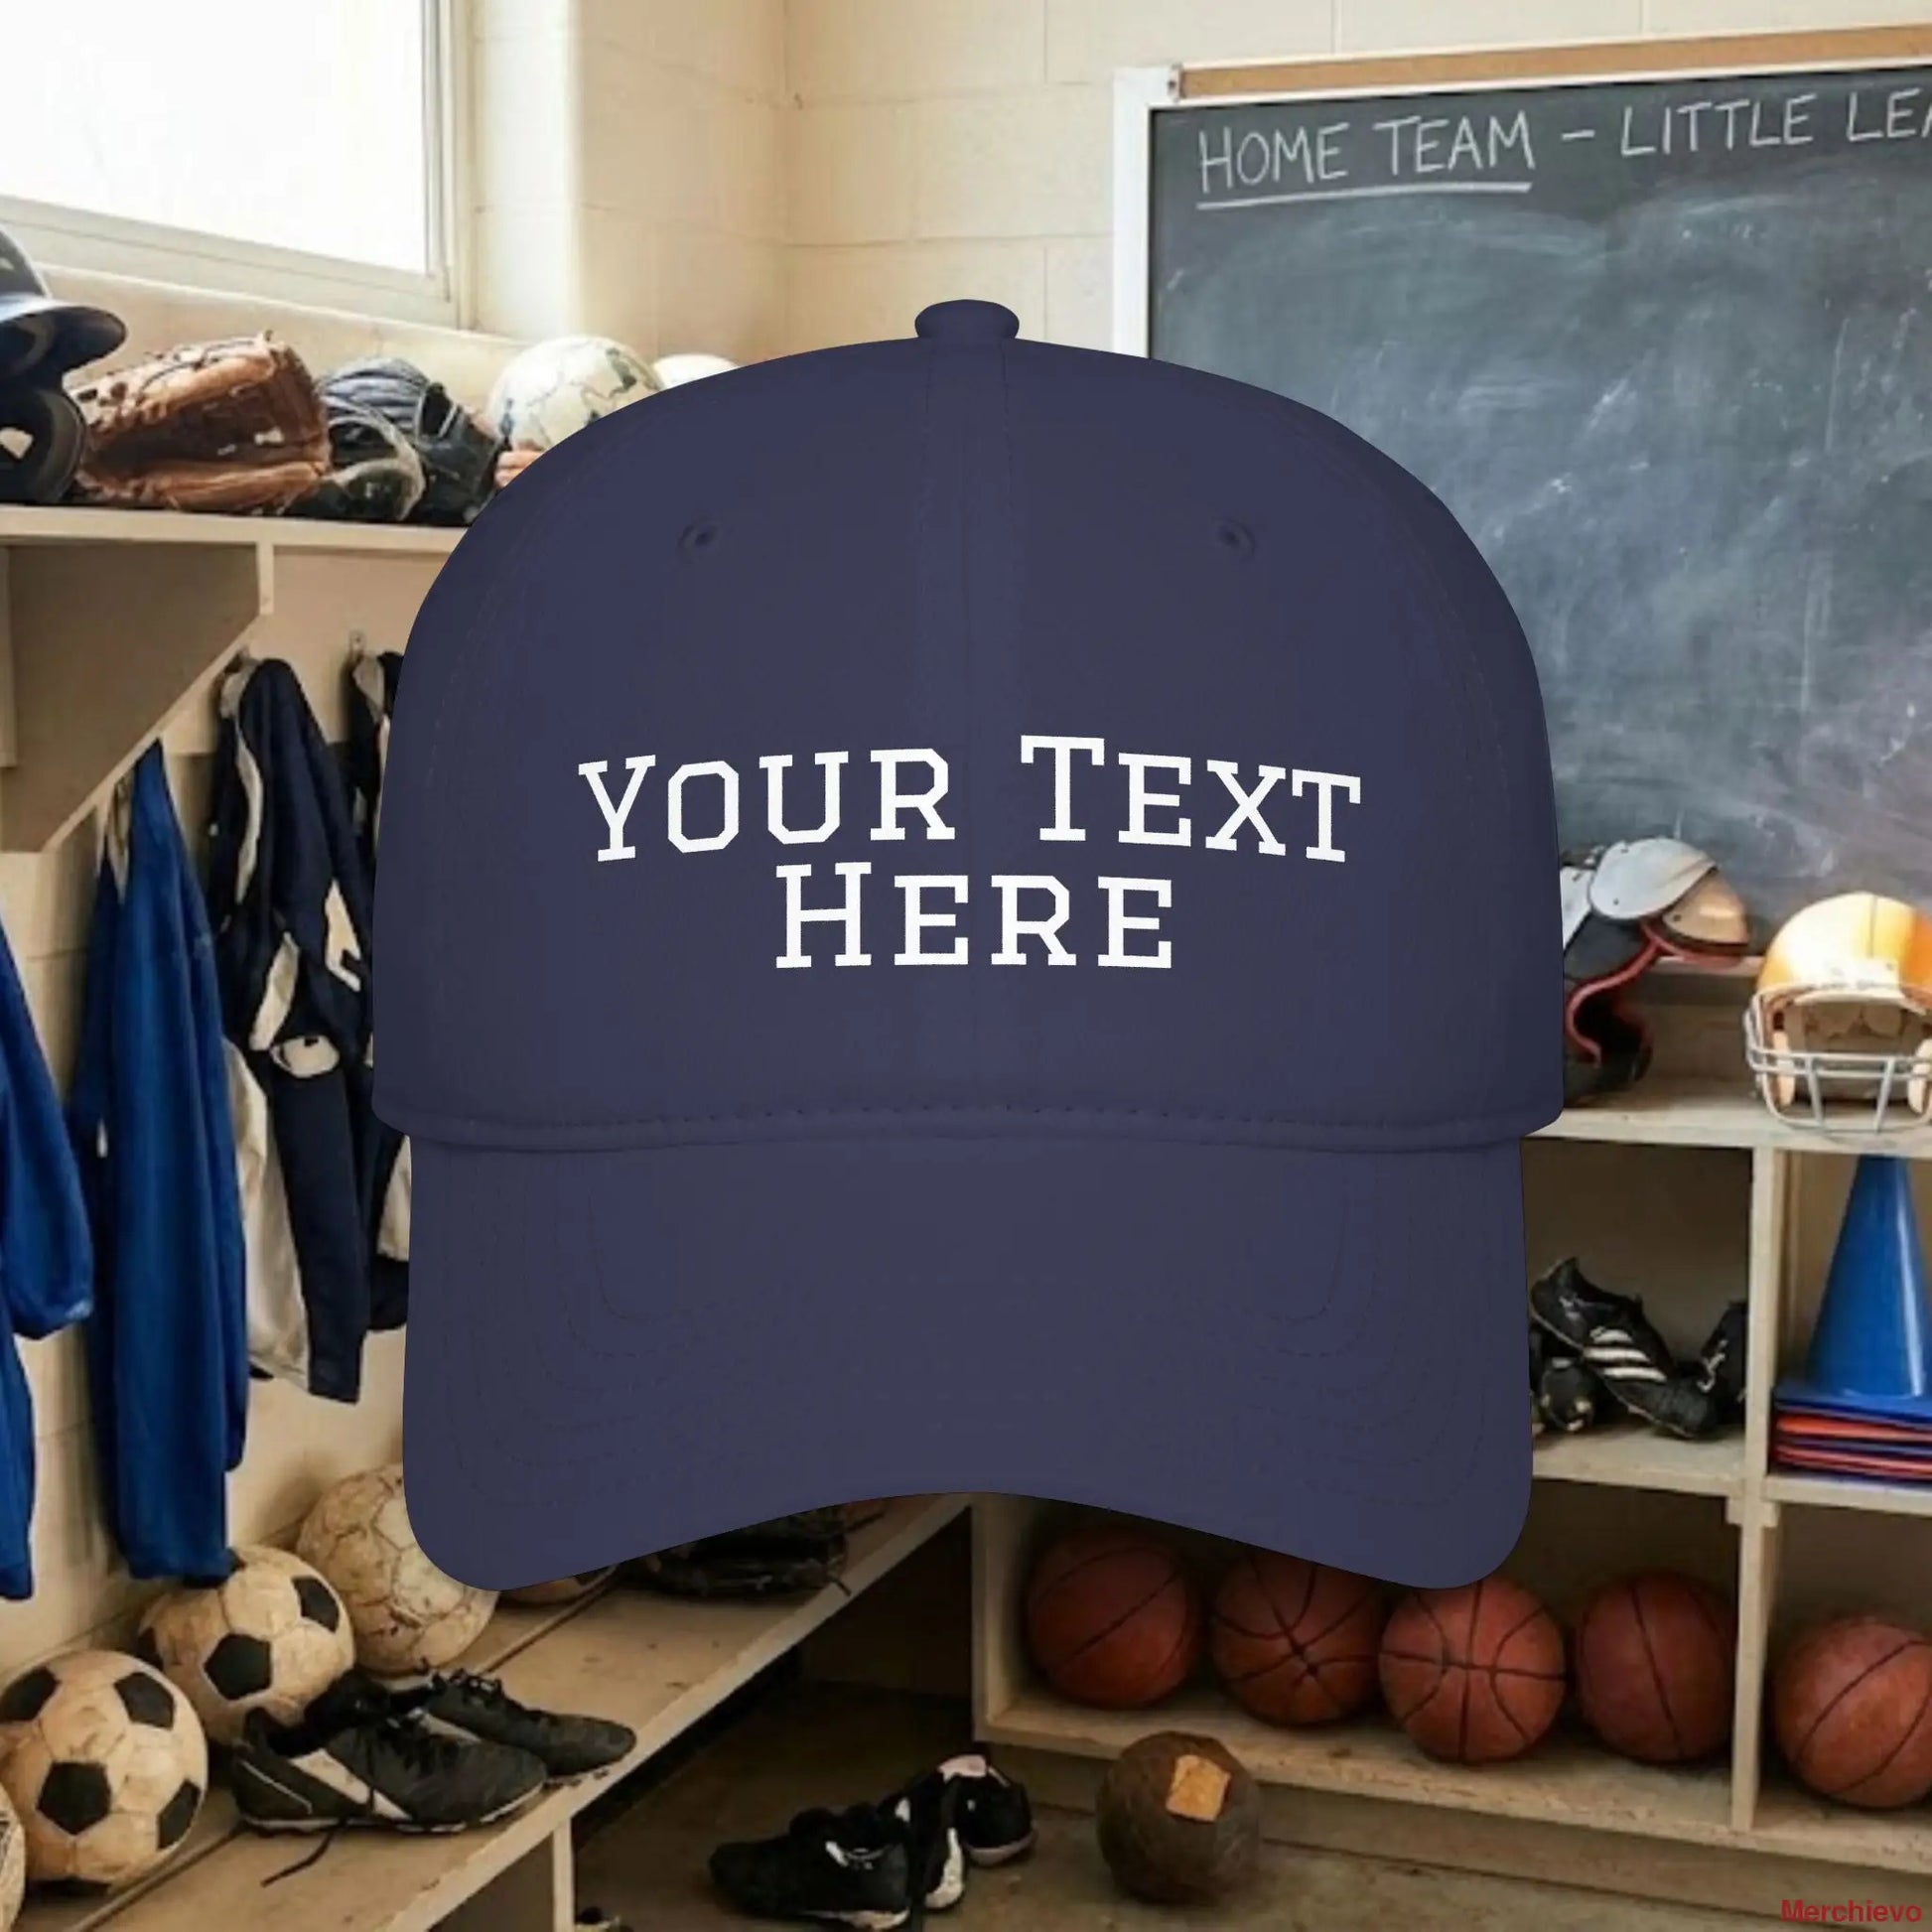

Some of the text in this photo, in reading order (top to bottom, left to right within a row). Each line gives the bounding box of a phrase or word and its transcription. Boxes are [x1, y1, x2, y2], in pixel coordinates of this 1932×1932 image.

[1197, 121, 1350, 193] HOME
[1373, 110, 1536, 178] TEAM
[1620, 93, 1819, 157] LITTLE
[579, 736, 1361, 862] YOUR TEXT
[776, 862, 1172, 968] HERE
